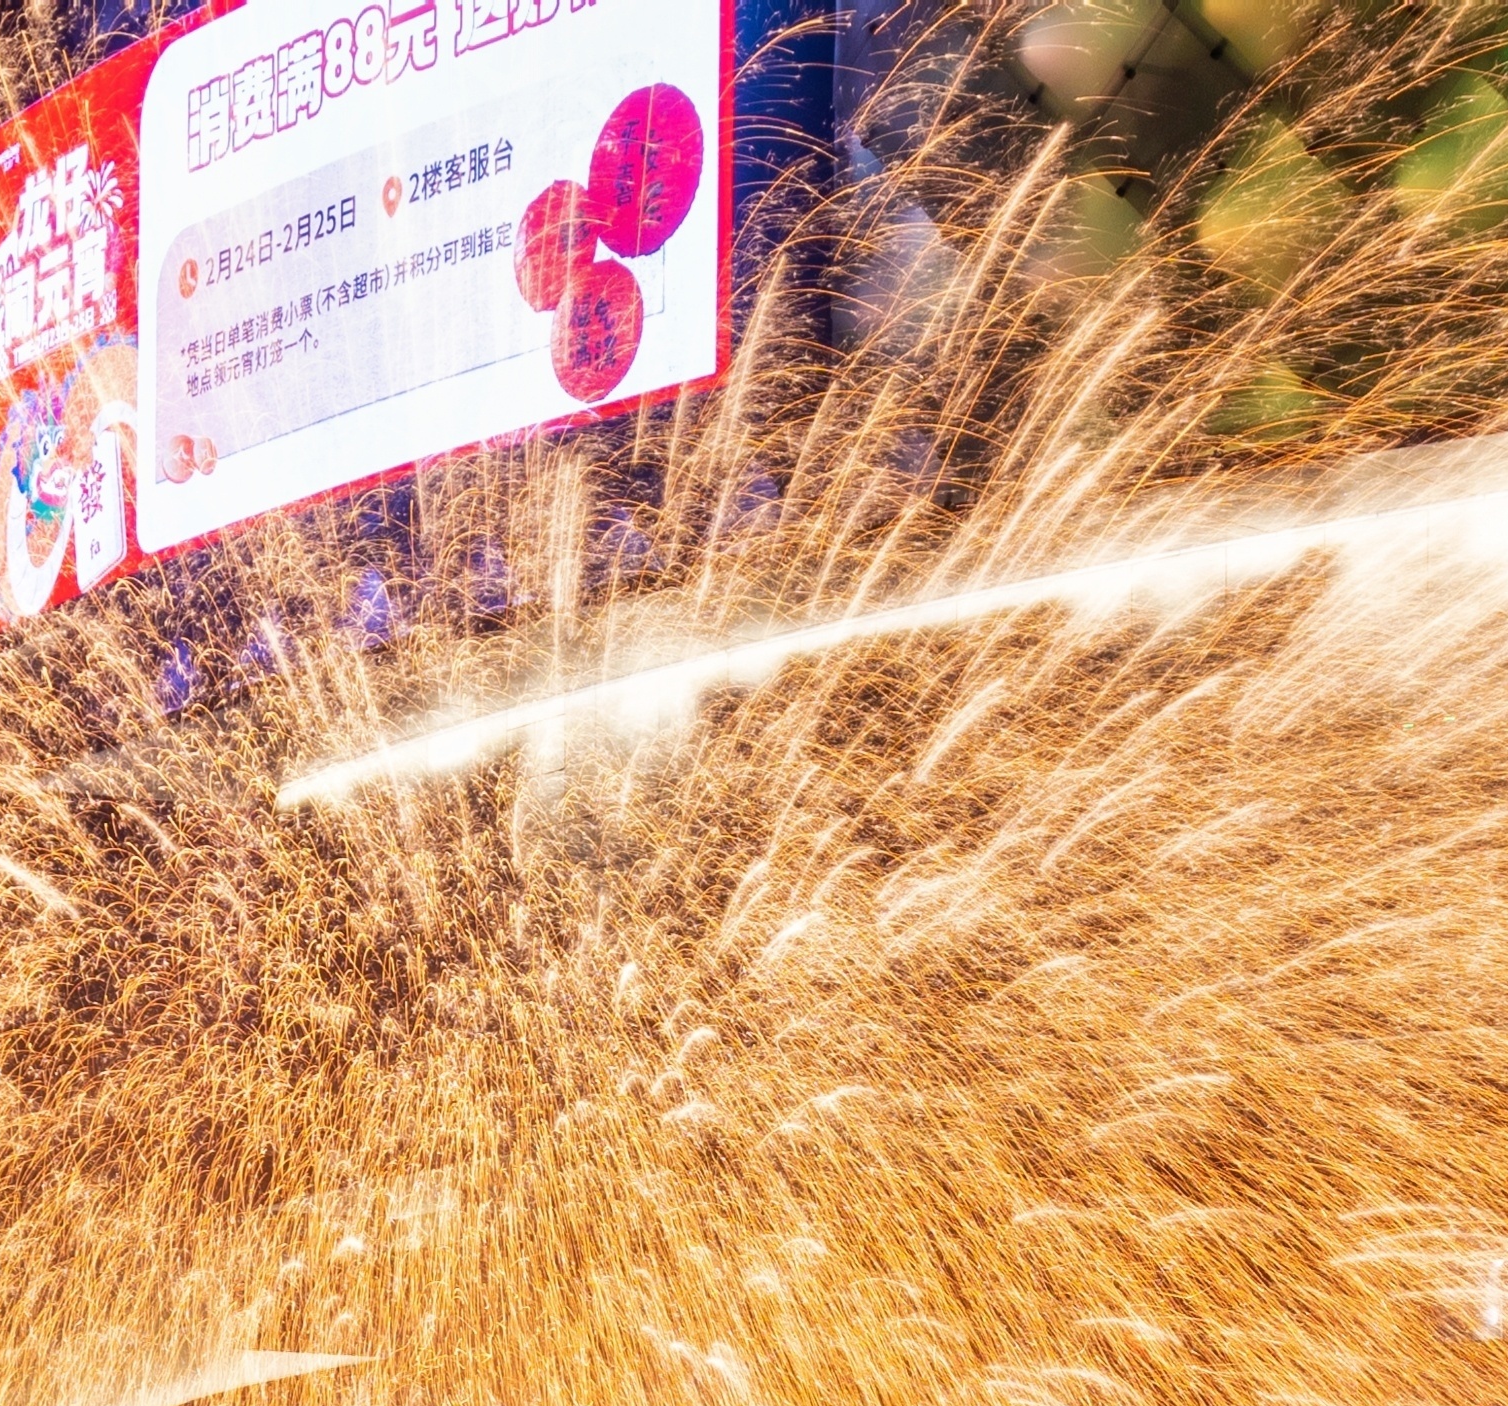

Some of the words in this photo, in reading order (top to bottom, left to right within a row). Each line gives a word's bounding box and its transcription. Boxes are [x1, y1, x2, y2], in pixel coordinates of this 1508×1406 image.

[188, 0, 438, 172] 消费满88元
[408, 137, 514, 204] 2楼客服台
[205, 195, 356, 286] 2月24日-2月25日
[186, 327, 320, 399] 地点领元宵灯笼一个。
[78, 460, 106, 524] 發
